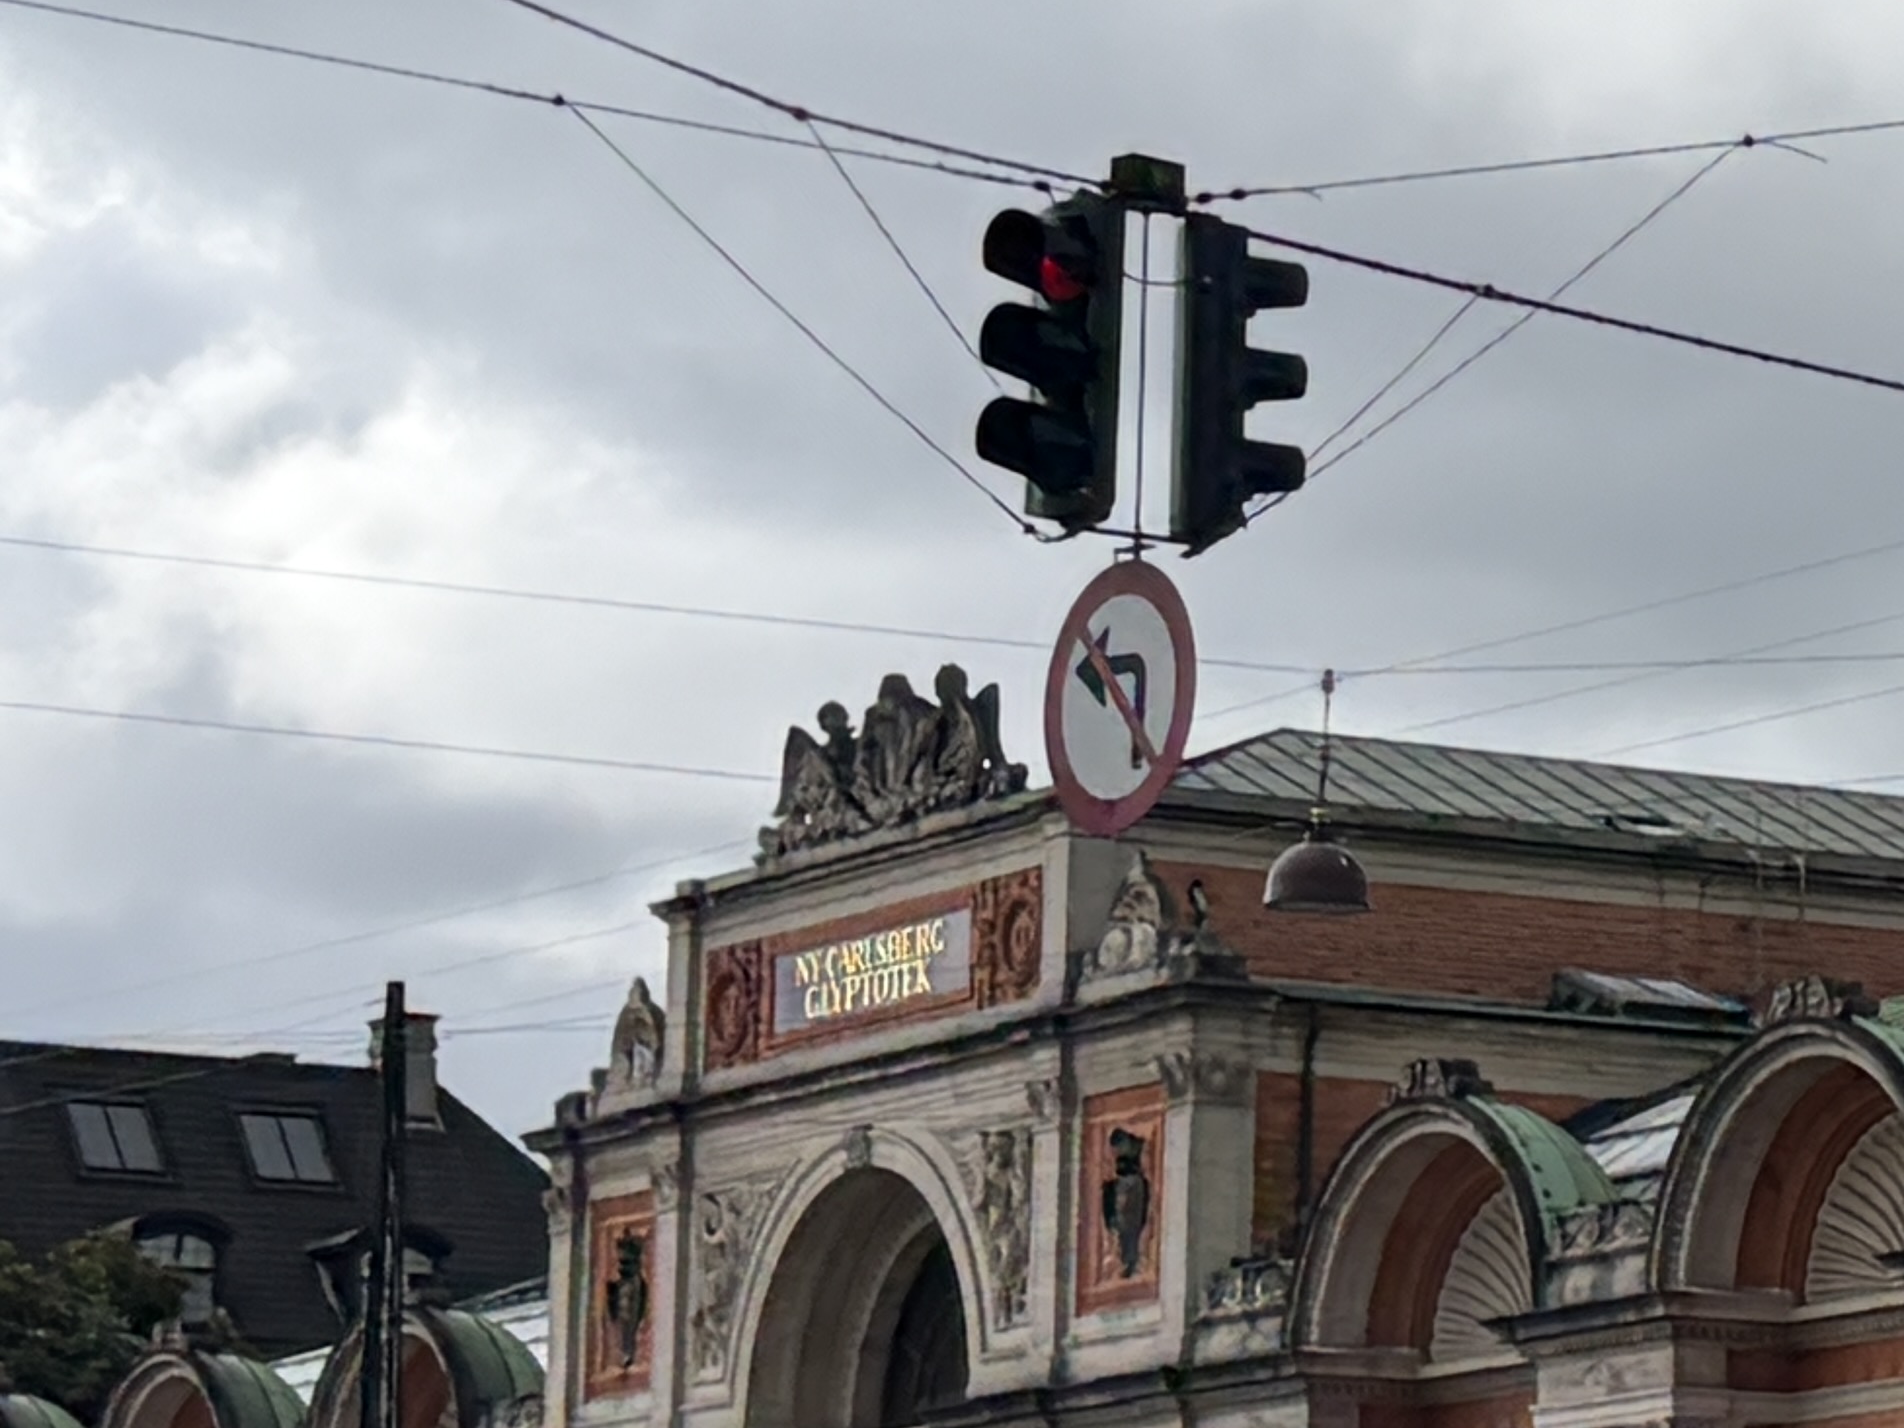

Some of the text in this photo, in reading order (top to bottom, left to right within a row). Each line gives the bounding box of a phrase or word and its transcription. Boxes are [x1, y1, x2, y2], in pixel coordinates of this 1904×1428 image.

[794, 918, 946, 988] NY CARLSBERG
[804, 958, 932, 1019] GLYPTOTEK
